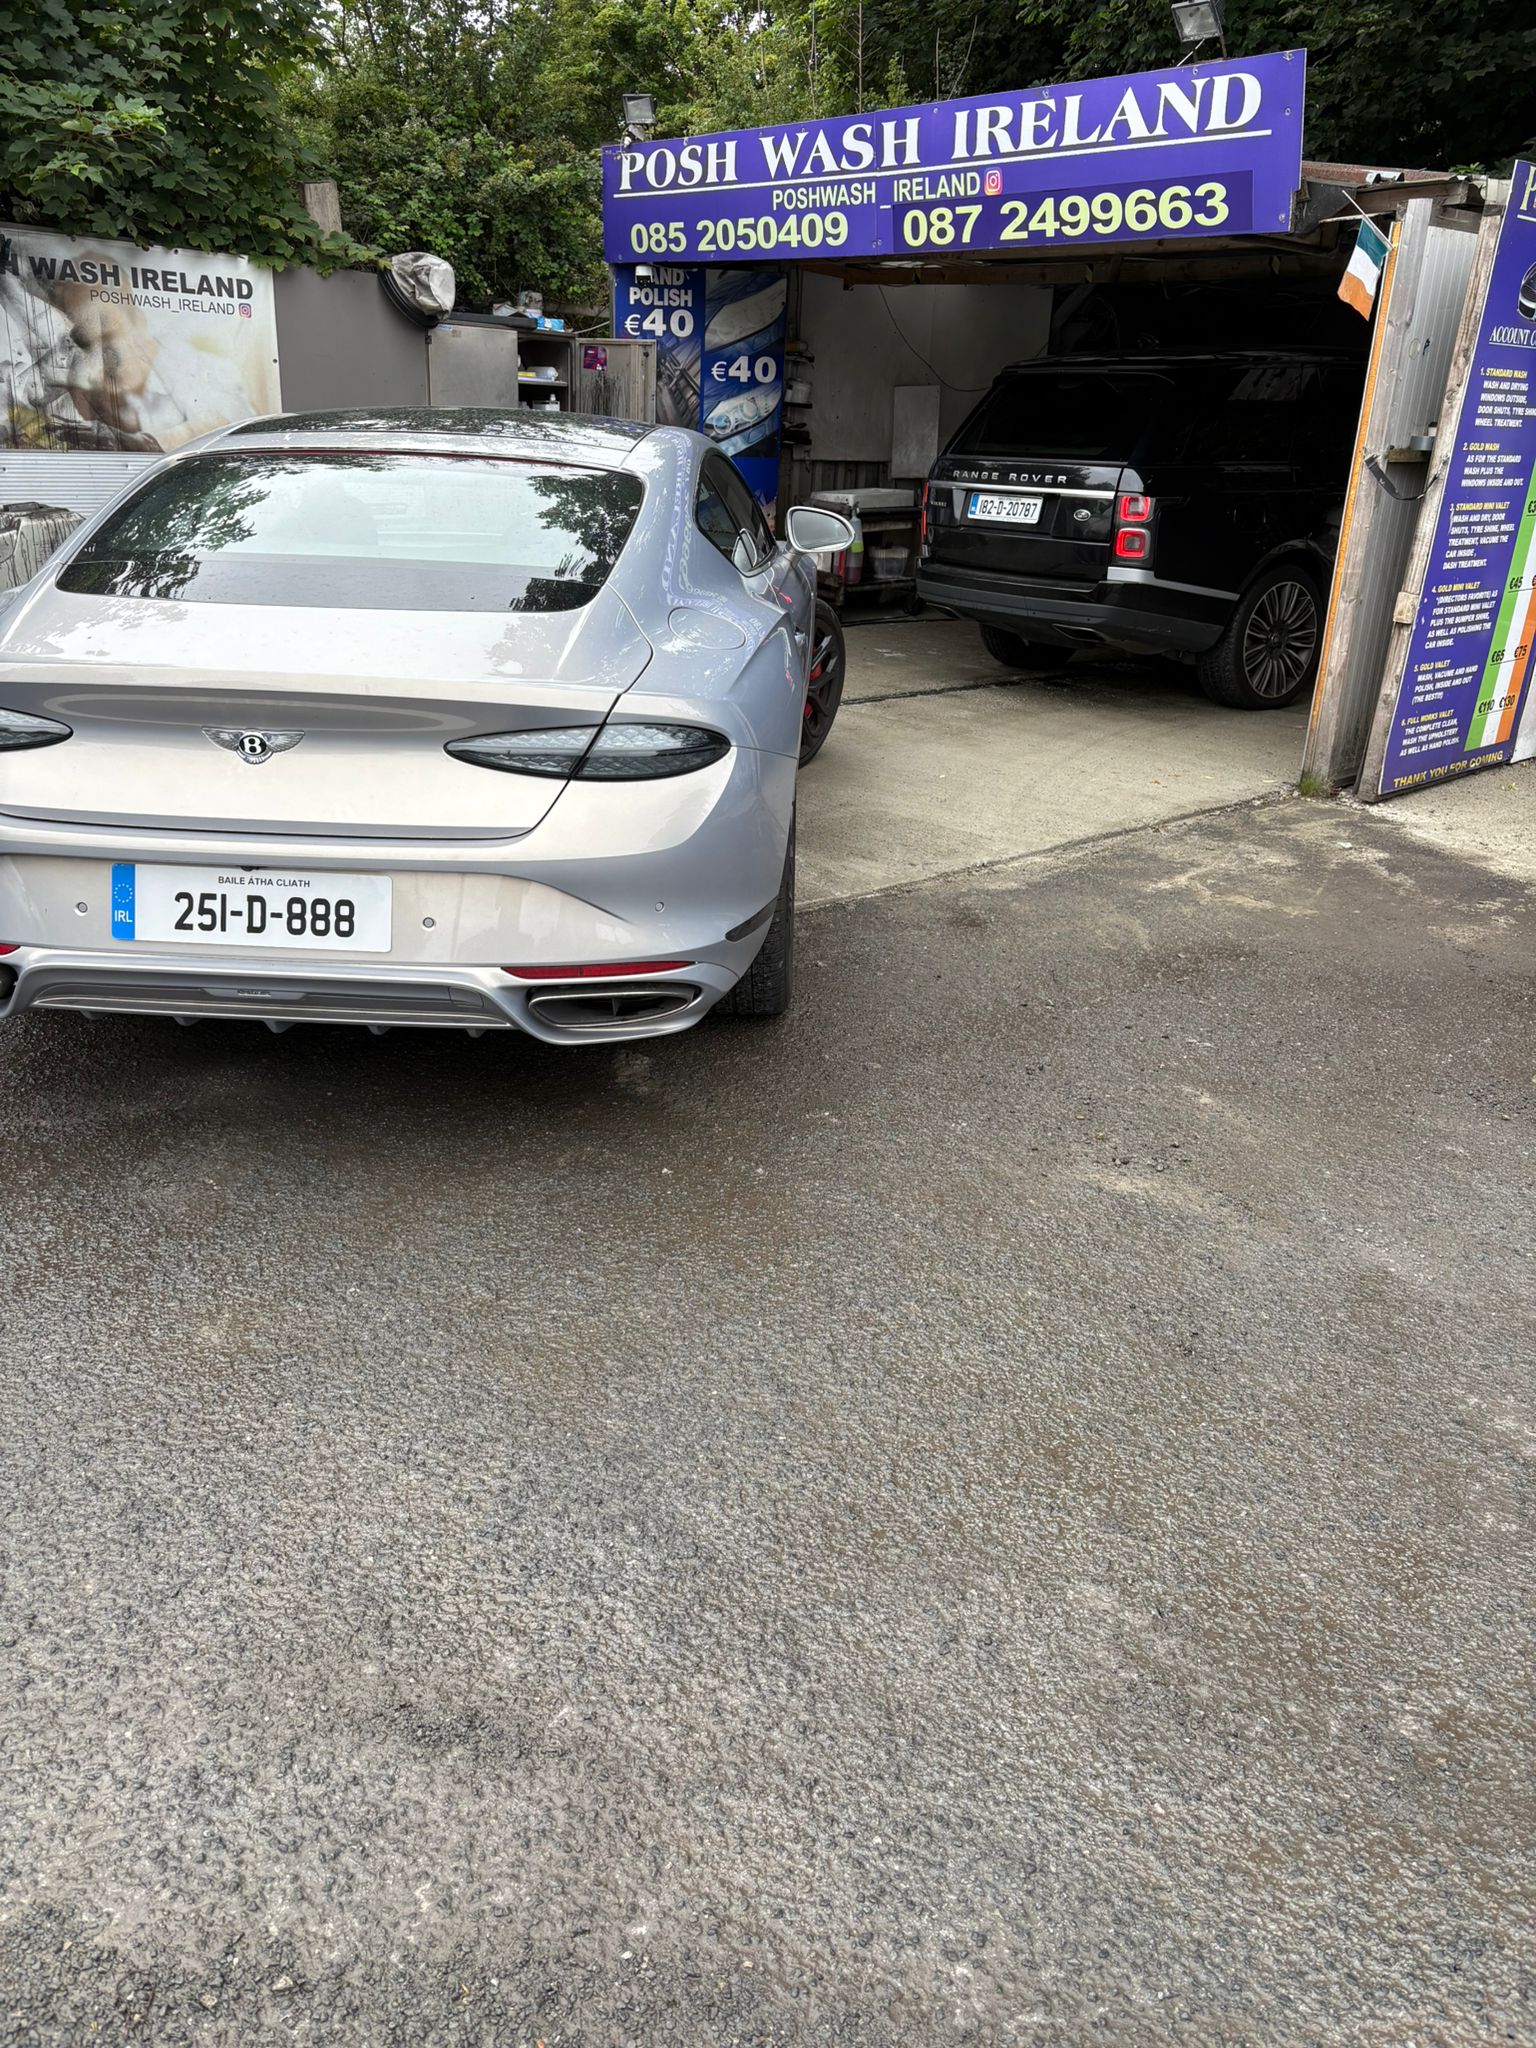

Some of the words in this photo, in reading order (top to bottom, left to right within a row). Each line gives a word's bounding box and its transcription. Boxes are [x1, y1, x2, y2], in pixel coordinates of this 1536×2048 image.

[619, 140, 738, 191] POSH
[758, 117, 920, 179] WASH
[951, 71, 1263, 160] IRELAND
[903, 204, 983, 248] 087
[1000, 182, 1230, 241] 2499663
[630, 222, 687, 254] 085
[696, 211, 849, 252] 2050409
[28, 256, 120, 287] WASH
[131, 267, 254, 300] IRELAND
[89, 289, 236, 316] POSHWASH_IRELAND
[629, 287, 693, 307] POLISH
[624, 308, 694, 338] €40
[1489, 326, 1531, 344] ACCOUNT
[711, 355, 777, 384] €40
[1480, 367, 1485, 376] 1.
[1486, 368, 1513, 378] STANDARD
[1513, 370, 1528, 379] WASH
[1483, 380, 1500, 390] WASH
[1499, 381, 1511, 390] AND
[1511, 383, 1529, 392] DRYING
[1480, 393, 1506, 402] WINDOWS
[1478, 405, 1493, 414] DOOR
[1512, 407, 1525, 416] TYRE
[1475, 418, 1493, 427] WHEEL
[1463, 442, 1469, 451] 2.
[1469, 443, 1484, 451] GOLD
[1485, 443, 1500, 451] WASH
[1466, 455, 1475, 463] AS
[1475, 455, 1486, 463] FOR
[1487, 455, 1497, 463] THE
[1497, 455, 1522, 463] STANDARD
[952, 470, 1000, 481] RANGE
[1008, 473, 1068, 485] ROVER
[1464, 467, 1480, 475] WASH
[1480, 467, 1494, 475] PLUS
[1494, 467, 1505, 475] THE
[1461, 479, 1487, 487] WINDOWS
[1486, 479, 1504, 487] INSIDE
[979, 500, 1038, 518] 182-D-20787
[1456, 503, 1483, 511] STANDARD
[1483, 502, 1495, 510] MINI
[1496, 502, 1511, 510] VALET
[1453, 515, 1470, 523] WASH
[1469, 514, 1481, 522] AND
[1492, 513, 1506, 521] DOOR
[1471, 526, 1484, 534] TYRE
[1500, 524, 1515, 532] WHEEL
[1500, 535, 1509, 543] THE
[1446, 550, 1457, 558] CAR
[1443, 561, 1457, 570] DASH
[1438, 584, 1453, 593] GOLD
[1453, 583, 1465, 592] MINI
[1465, 582, 1481, 591] VALET
[1510, 577, 1524, 590] €45
[1491, 589, 1498, 598] AS
[1433, 607, 1444, 615] FOR
[1444, 605, 1470, 615] STANDARD
[1470, 603, 1482, 611] MINI
[1481, 601, 1496, 610] VALET
[1430, 618, 1444, 627] PLUS
[1445, 617, 1455, 625] THE
[1455, 614, 1475, 624] BUMPER
[1427, 631, 1435, 639] AS
[1436, 629, 1449, 637] WELL
[1457, 624, 1482, 634] POLISHING
[1482, 622, 1492, 631] THE
[1425, 641, 1437, 650] CAR
[1492, 650, 1506, 663] €65
[1515, 645, 1528, 658] €75
[1420, 662, 1435, 671] GOLD
[1435, 660, 1451, 670] VALET
[1455, 667, 1465, 676] AND
[1465, 665, 1479, 674] HAND
[1435, 680, 1452, 690] INSIDE
[1452, 678, 1462, 686] AND
[1462, 676, 1473, 684] OUT
[1479, 700, 1495, 714] €110
[1499, 695, 1515, 708] €130
[1407, 717, 1420, 725] FULL
[1420, 712, 1439, 723] WORKS
[1439, 709, 1455, 720] VALET
[1405, 727, 1416, 736] THE
[1416, 722, 1441, 733] COMPLETE
[1402, 736, 1418, 746] WASH
[1418, 734, 1428, 743] THE
[1428, 728, 1459, 741] UPHOLSTERY
[1400, 749, 1408, 757] AS
[1408, 746, 1421, 755] WELL
[1429, 740, 1442, 750] HAND
[1394, 771, 1428, 788] THANK
[1430, 766, 1448, 777] YOU
[1470, 751, 1503, 767] COMING
[217, 876, 246, 886] BAILE
[247, 875, 275, 887] ÁTHA
[275, 878, 311, 889] CLIATH
[114, 910, 133, 923] IRL
[174, 891, 355, 938] 251-D-888
